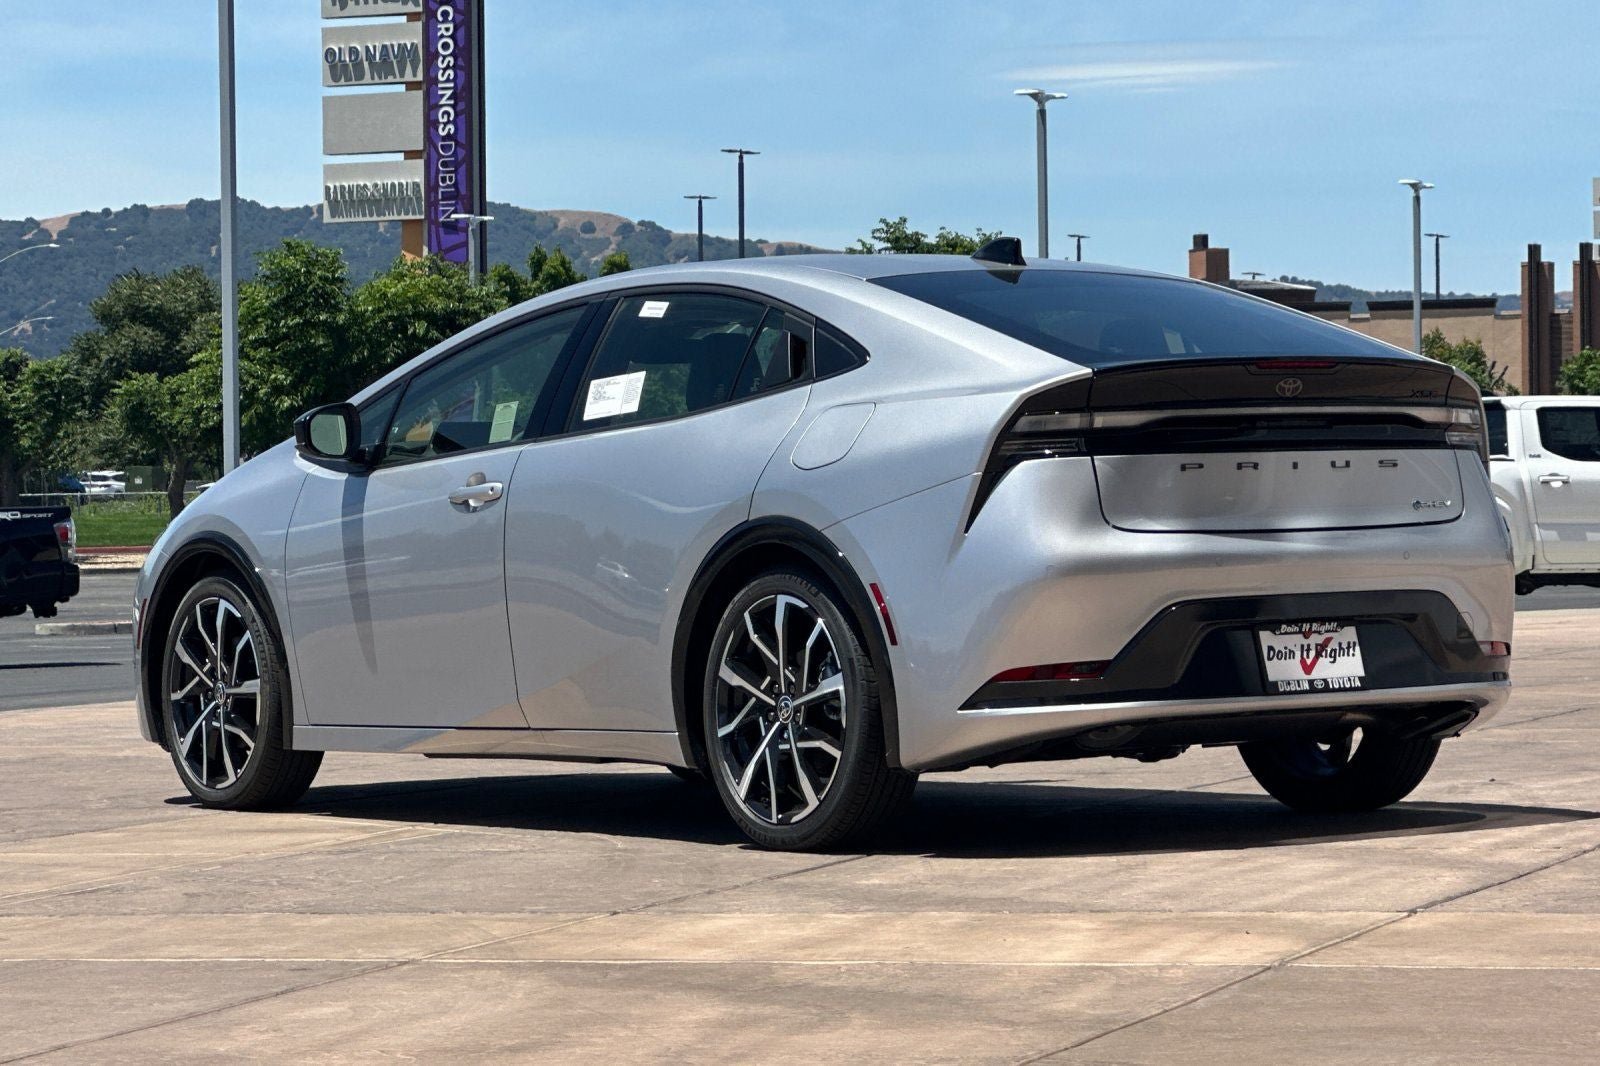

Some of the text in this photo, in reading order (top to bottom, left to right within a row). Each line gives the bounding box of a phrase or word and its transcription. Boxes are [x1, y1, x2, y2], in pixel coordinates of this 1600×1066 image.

[324, 40, 419, 64] OLD NAVY
[437, 5, 455, 222] CROSSINGS DUBLIN
[1180, 459, 1399, 472] PRIUS
[1267, 641, 1357, 664] Doin' It Right!
[1278, 676, 1361, 692] DUBLIN TOYOTA
